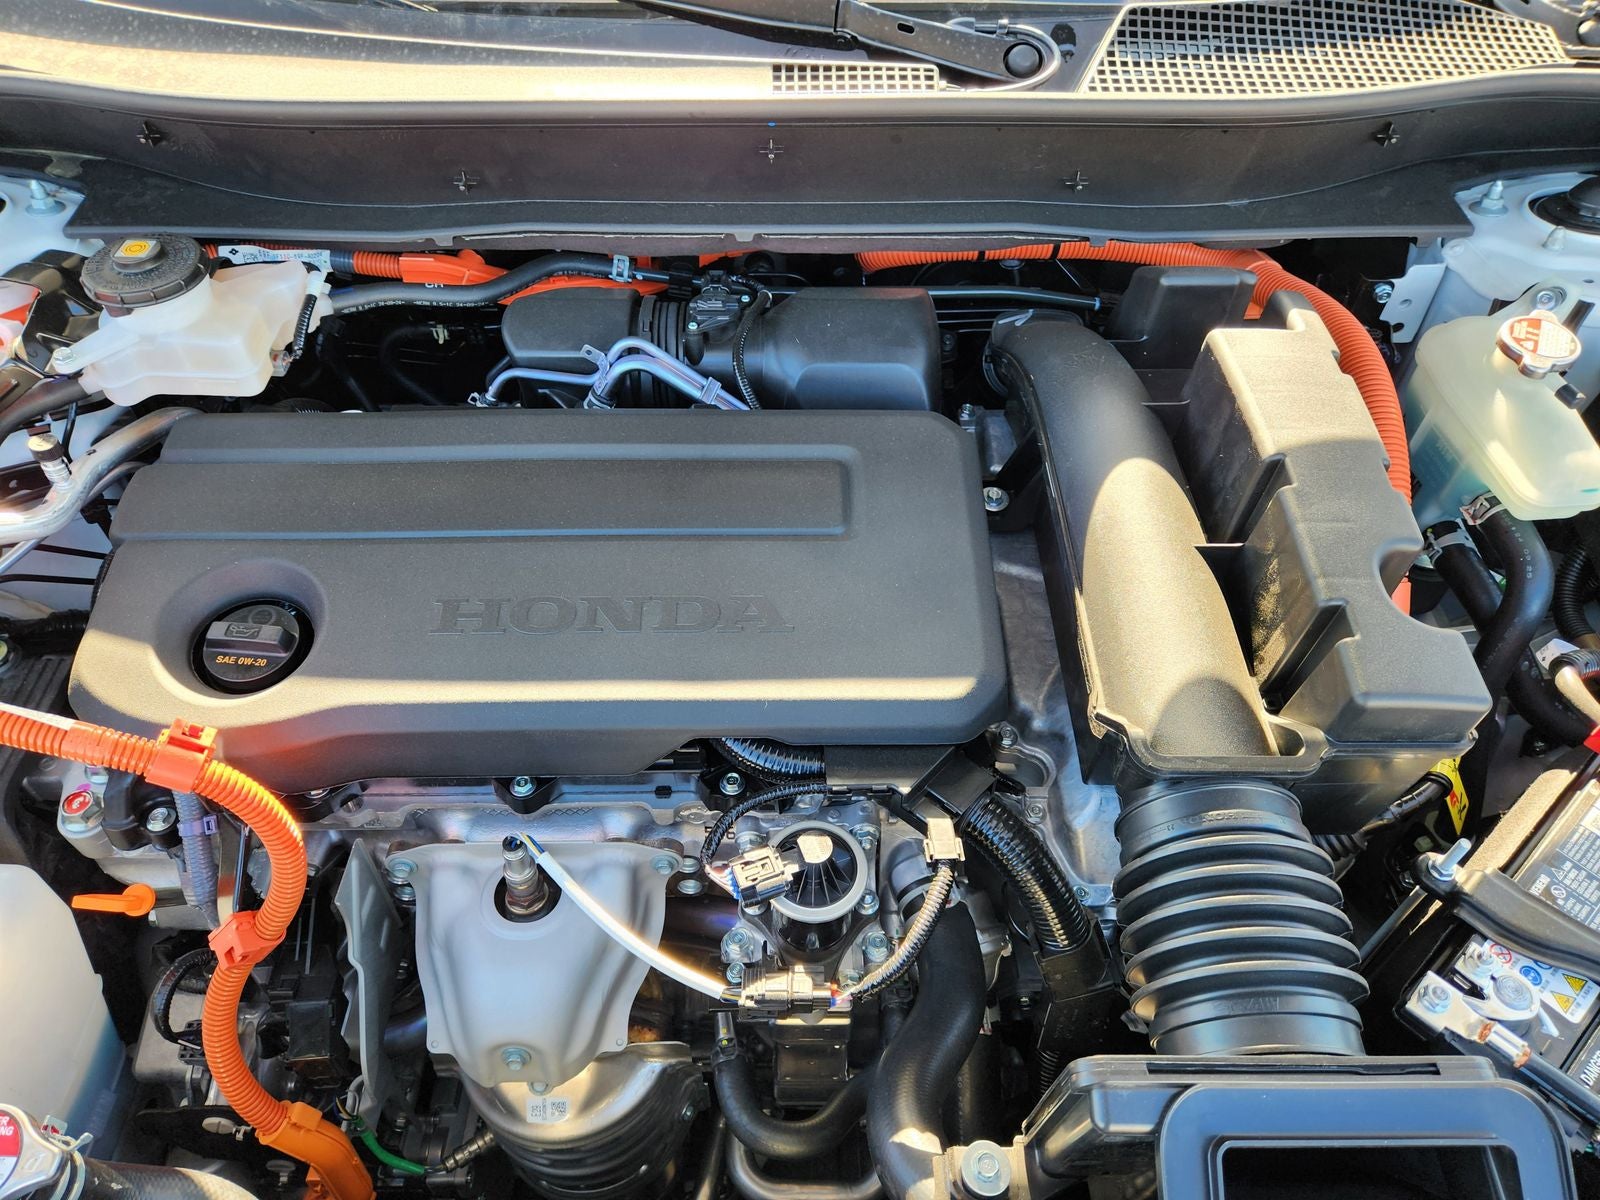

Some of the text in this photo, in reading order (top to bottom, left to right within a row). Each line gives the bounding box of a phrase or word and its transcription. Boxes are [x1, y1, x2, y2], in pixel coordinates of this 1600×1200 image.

[428, 593, 795, 635] HONDA
[215, 655, 268, 667] SAE 0W-20
